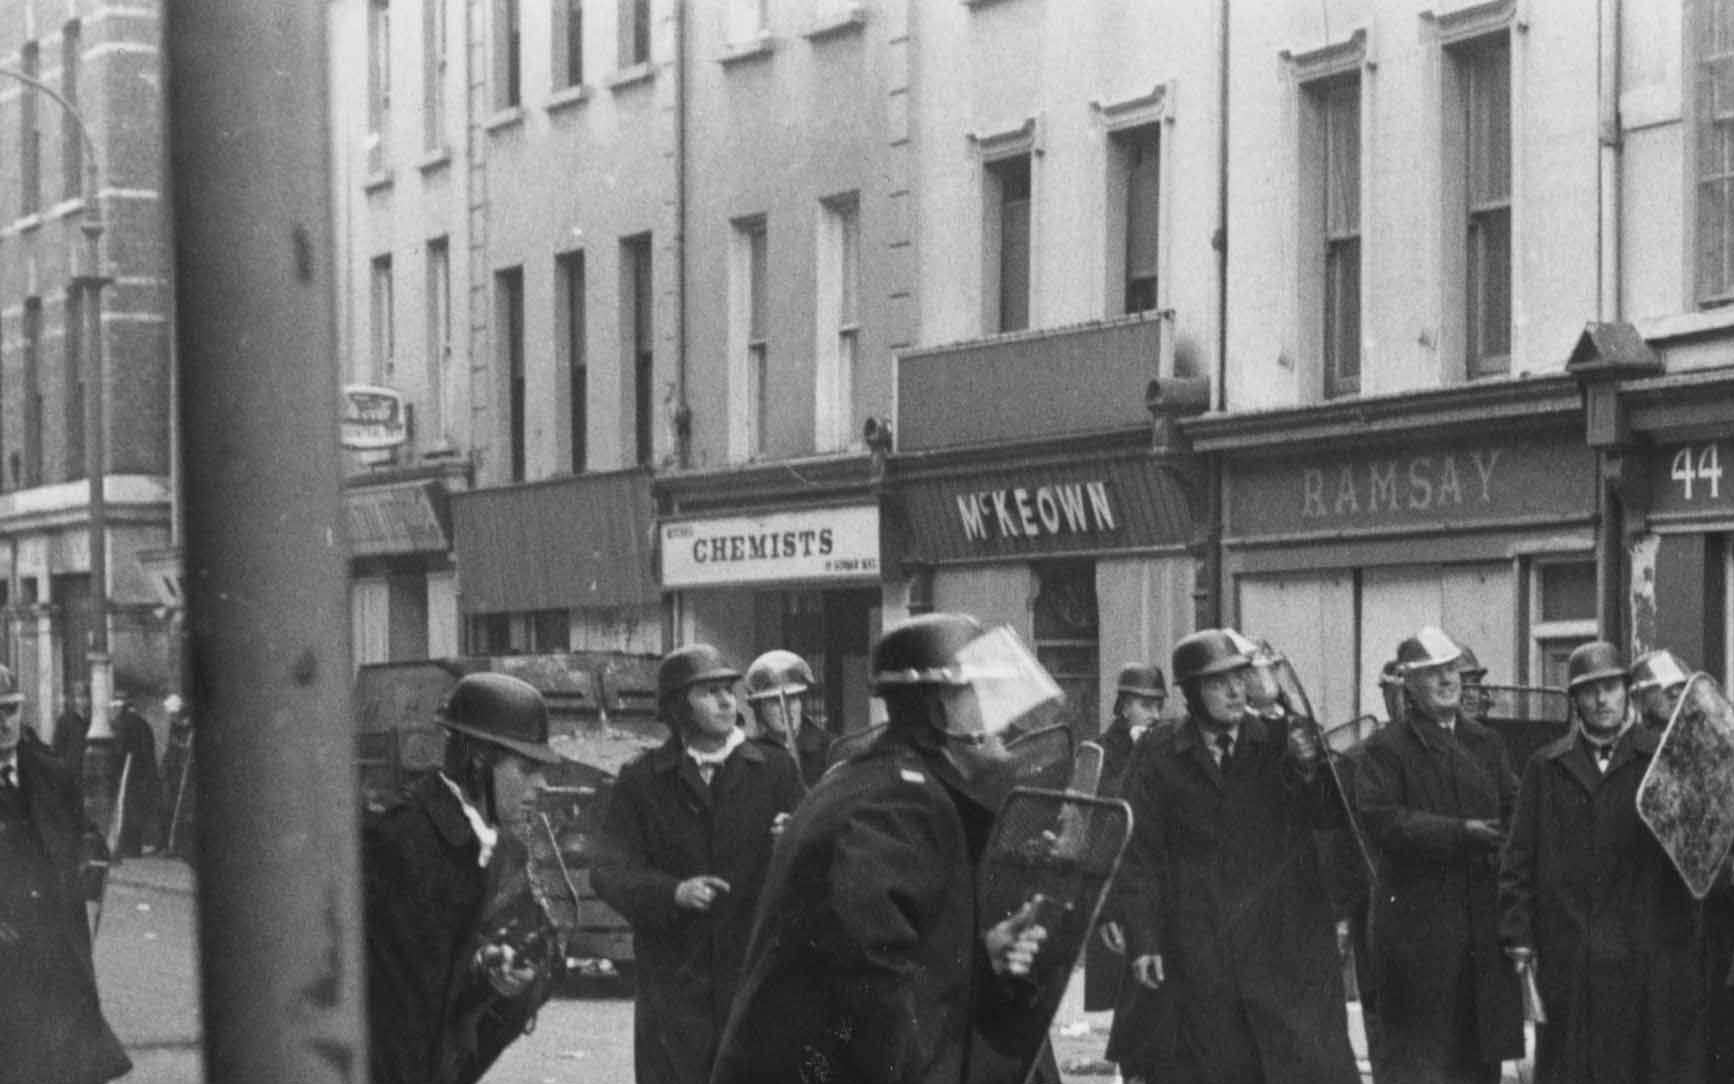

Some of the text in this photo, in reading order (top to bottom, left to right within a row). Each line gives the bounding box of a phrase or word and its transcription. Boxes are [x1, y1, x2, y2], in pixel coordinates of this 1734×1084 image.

[1301, 452, 1501, 517] RAMSAY
[1671, 445, 1723, 500] 44
[692, 528, 834, 564] CHEMISTS
